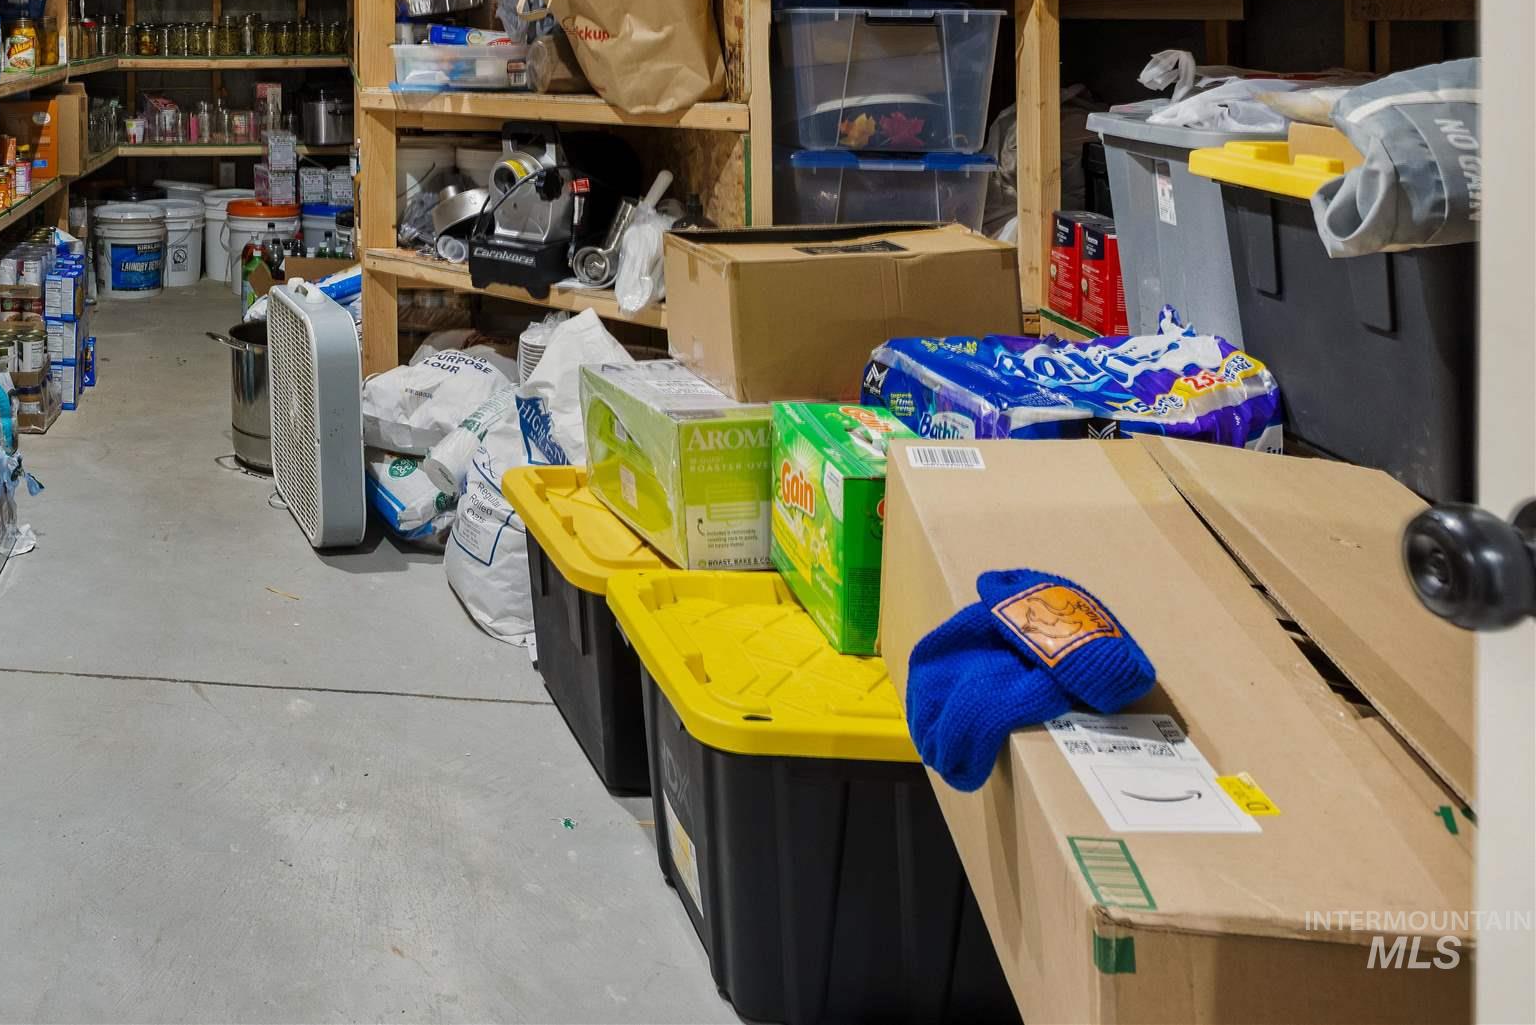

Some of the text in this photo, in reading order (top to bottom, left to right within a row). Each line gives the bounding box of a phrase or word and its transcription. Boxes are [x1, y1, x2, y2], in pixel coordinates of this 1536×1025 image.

[121, 261, 149, 272] LAUNDRY
[474, 247, 537, 267] Carnivore
[781, 460, 815, 517] Gain
